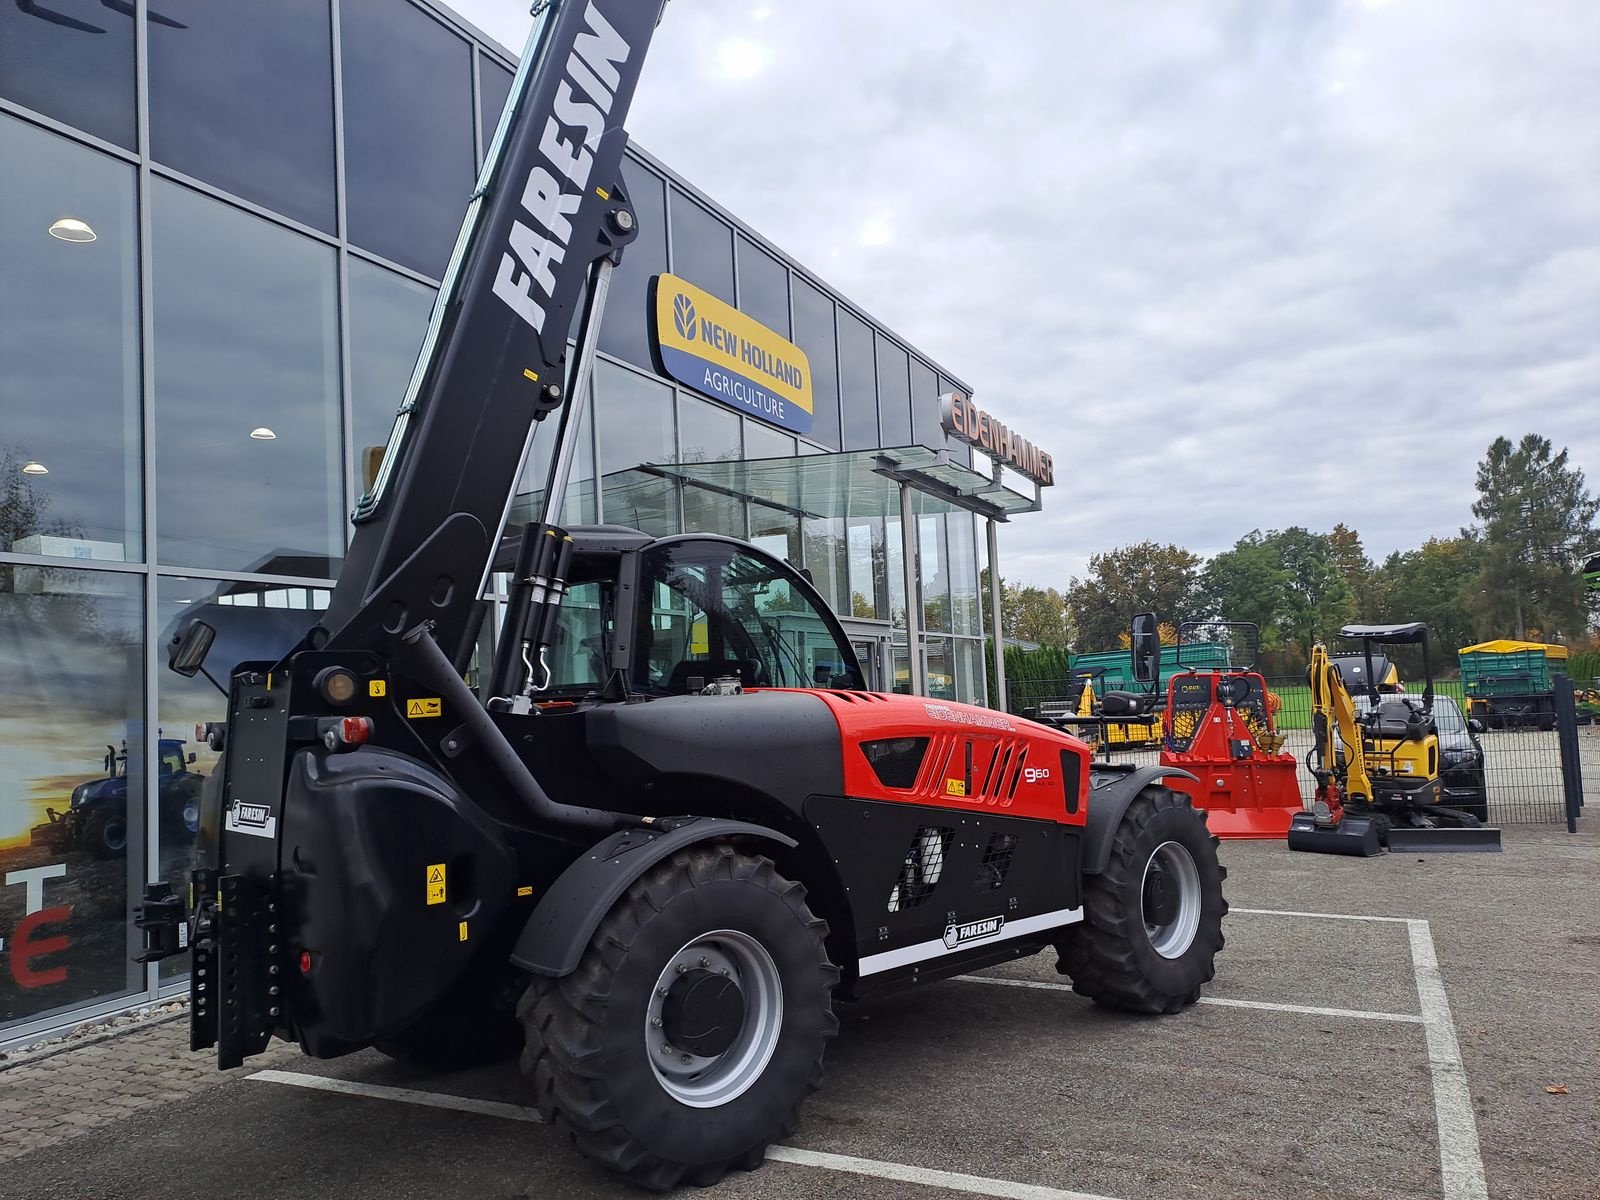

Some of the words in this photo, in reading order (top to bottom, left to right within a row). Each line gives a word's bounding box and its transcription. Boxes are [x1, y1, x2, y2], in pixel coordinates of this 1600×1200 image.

[492, 0, 631, 334] FARESIN
[701, 317, 737, 357] NEW
[741, 338, 803, 390] HOLLAND
[703, 367, 785, 419] AGRICULTURE
[949, 391, 1054, 484] EIDENHAMMER
[1024, 768, 1050, 783] 960
[240, 806, 266, 822] FARESIN
[960, 919, 998, 940] FARESIN
